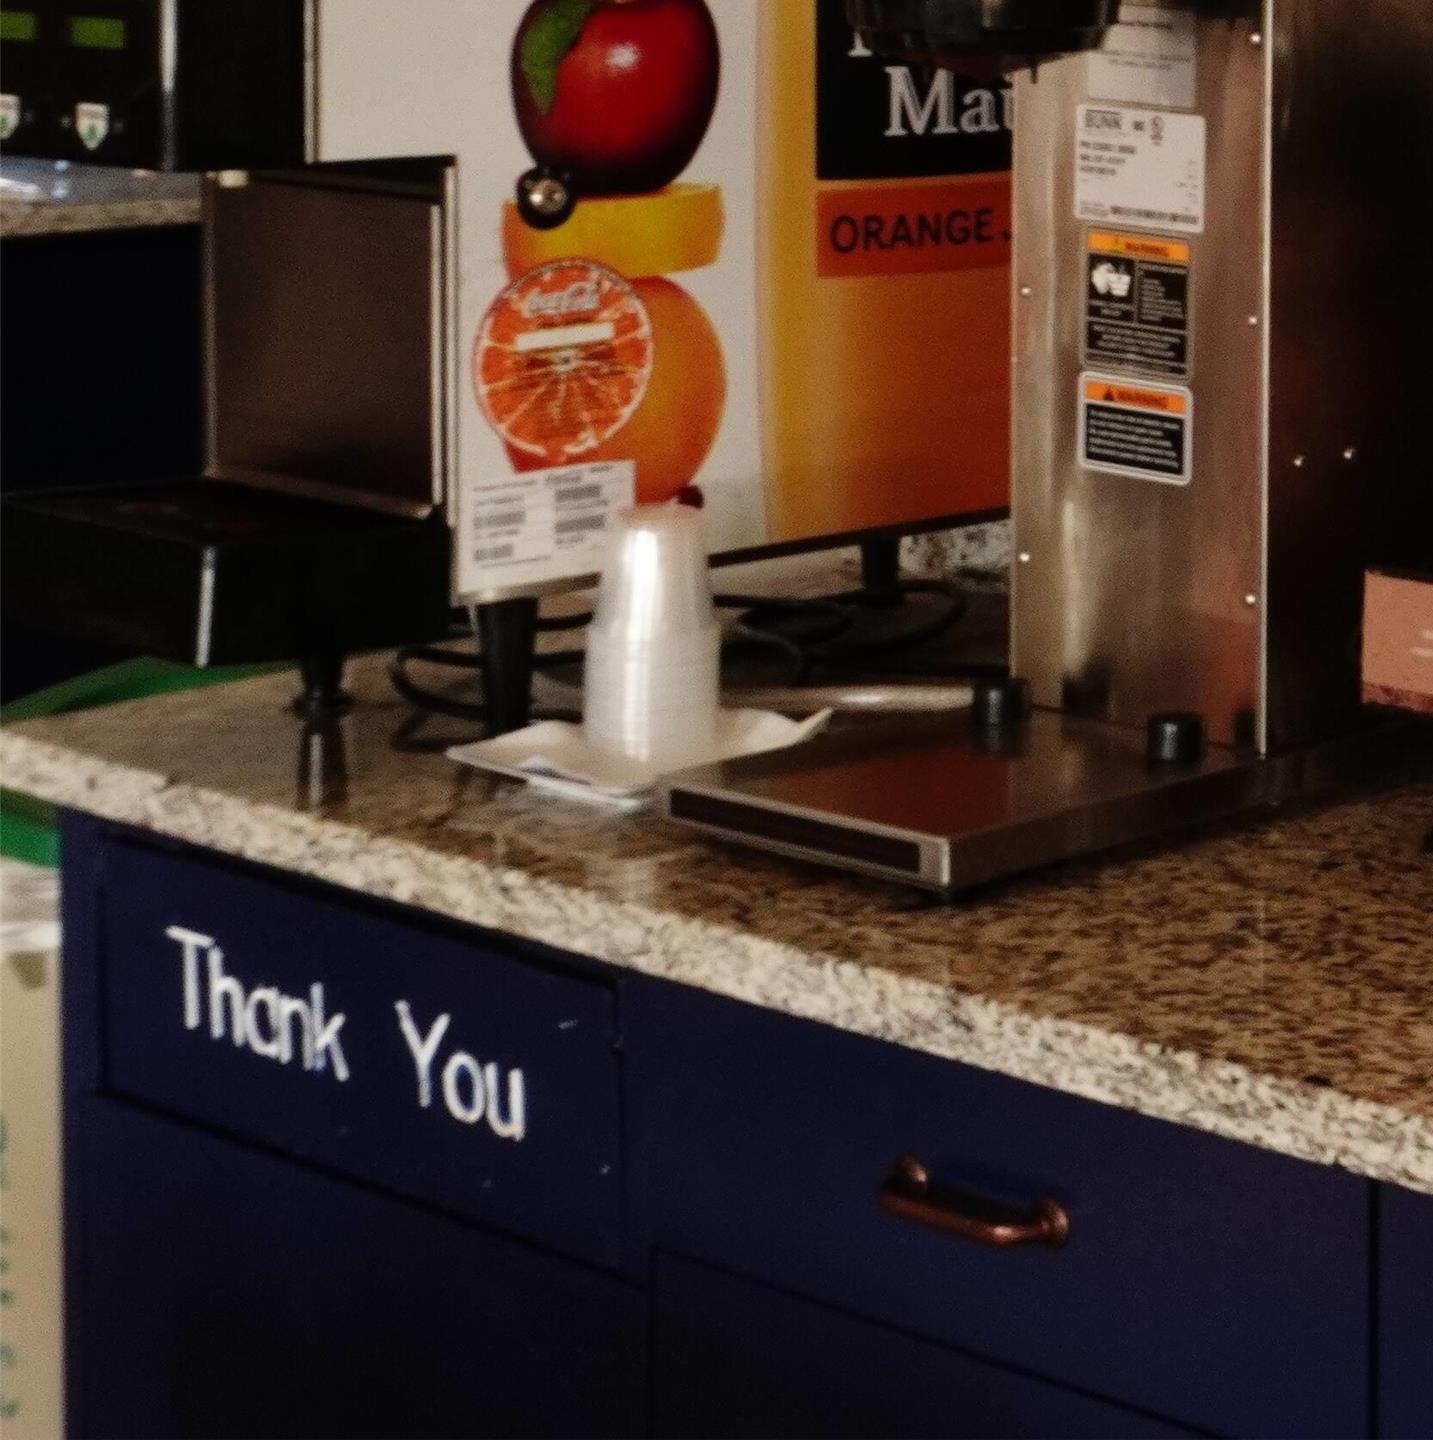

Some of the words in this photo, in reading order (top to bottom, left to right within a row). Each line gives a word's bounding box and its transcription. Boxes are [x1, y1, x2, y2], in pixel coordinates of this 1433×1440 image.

[830, 207, 994, 254] ORANGE
[165, 924, 350, 1083] Thank
[395, 1000, 527, 1142] You
